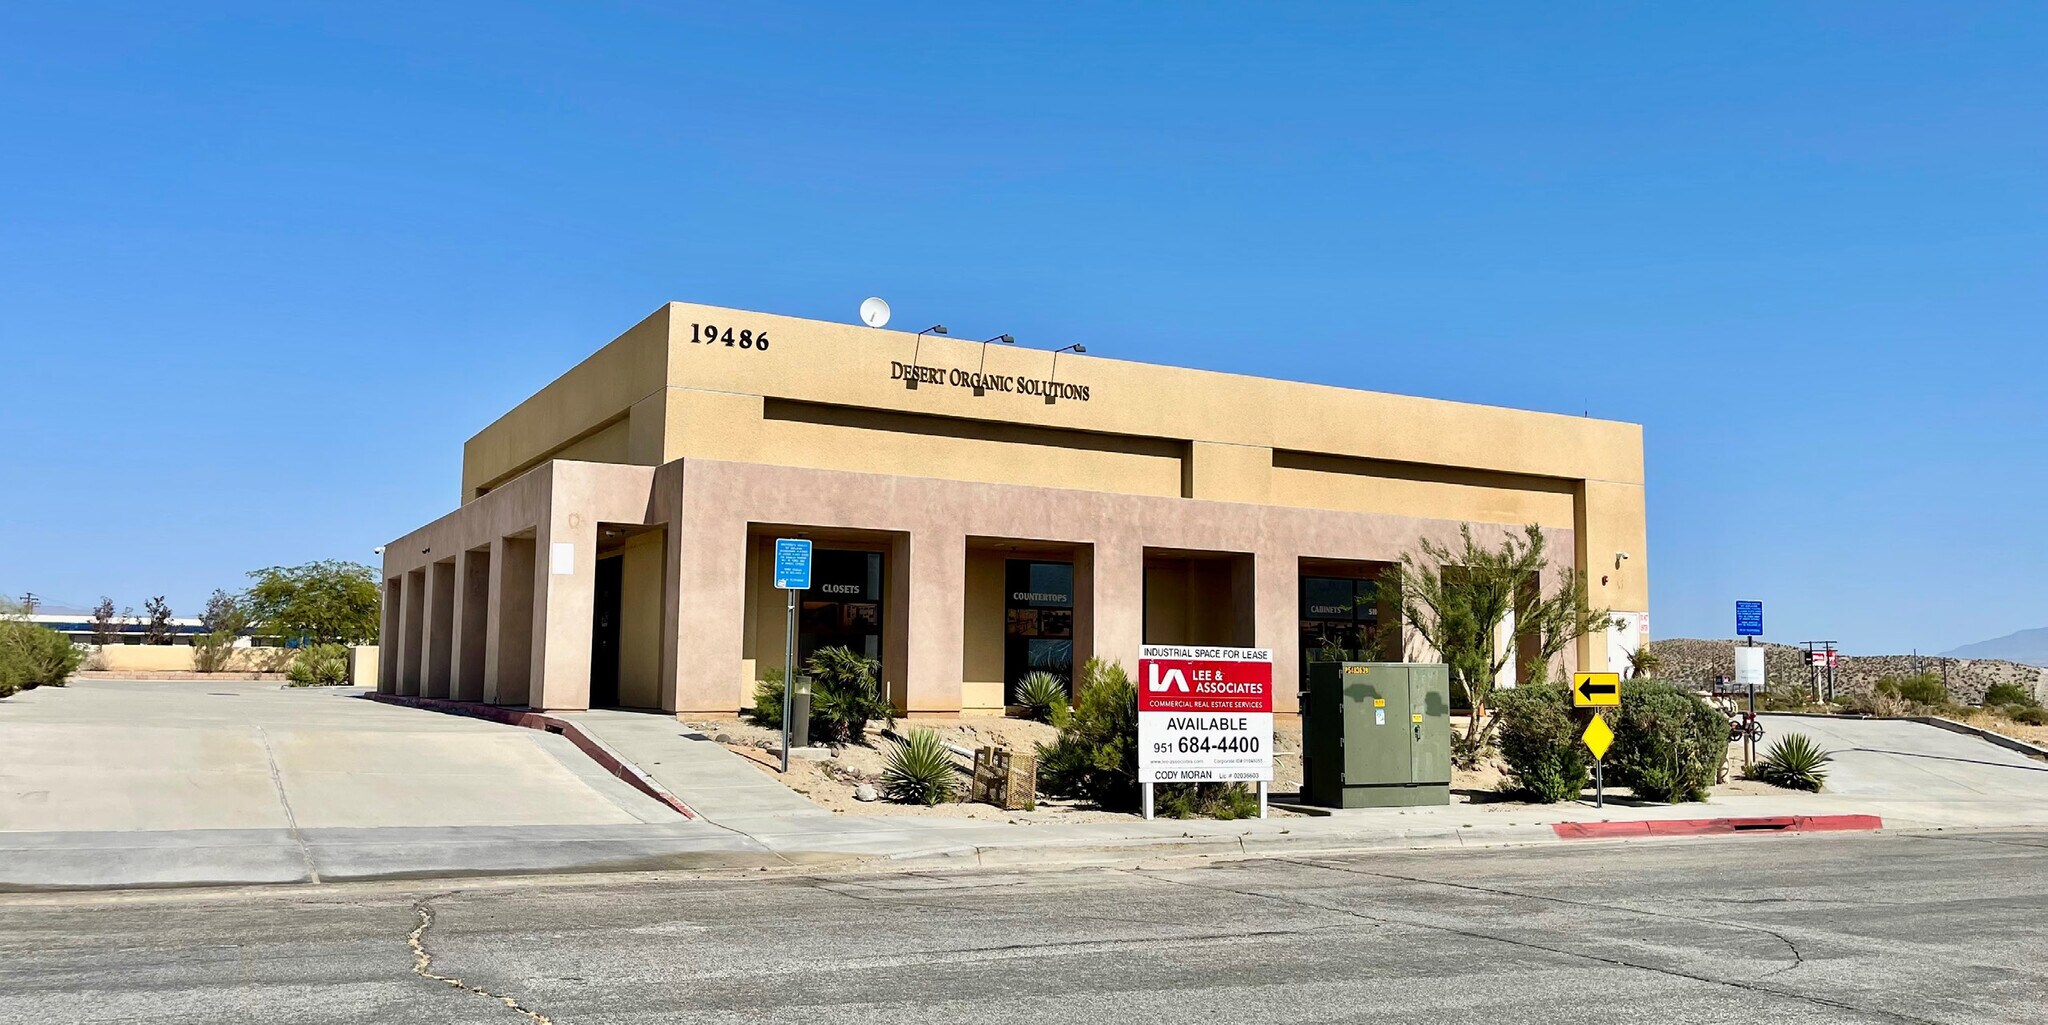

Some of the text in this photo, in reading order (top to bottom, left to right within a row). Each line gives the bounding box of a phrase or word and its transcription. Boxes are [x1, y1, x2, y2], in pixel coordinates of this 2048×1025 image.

[690, 323, 770, 351] 19486
[890, 360, 1090, 402] DESERT ORGANIC SOLUTIONS
[822, 583, 860, 594] CLOSETS
[1013, 591, 1067, 603] COUNTERTOPS
[1310, 605, 1342, 614] CABINETS
[1144, 647, 1268, 660] INDUSTRIAL SPACE FOR LEASE
[1192, 669, 1223, 681] LEE &
[1195, 682, 1263, 694] ASSOCIATES
[1149, 700, 1263, 709] COMMERCIAL REAL ESTATE SERVICES
[1166, 717, 1248, 731] AVAILABLE
[1153, 736, 1260, 754] 951 684-4400
[1155, 770, 1179, 780] CODY
[1180, 770, 1213, 780] MORAN
